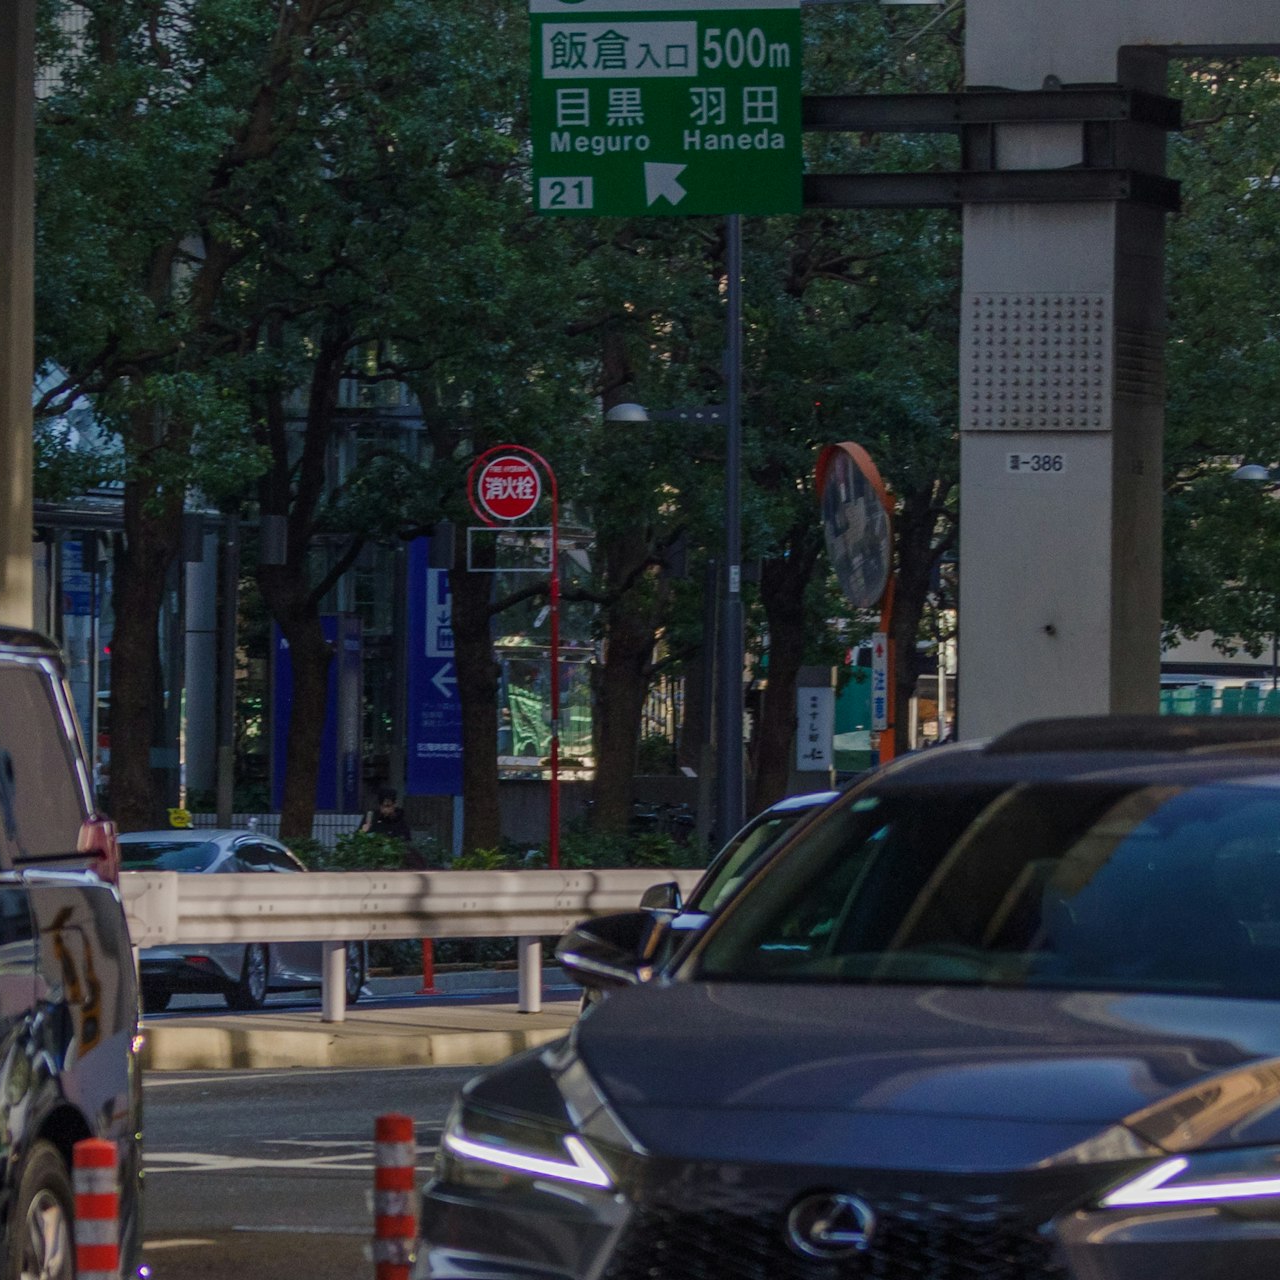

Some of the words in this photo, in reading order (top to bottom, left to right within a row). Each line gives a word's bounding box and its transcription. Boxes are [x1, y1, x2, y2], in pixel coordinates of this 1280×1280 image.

[550, 29, 689, 70] 飯倉入口
[703, 27, 791, 70] 500m
[556, 87, 645, 128] 目黒
[689, 86, 779, 126] 羽田
[549, 131, 651, 156] Meguro
[683, 129, 786, 151] Haneda
[549, 181, 584, 205] 21
[485, 476, 535, 500] 消火栓
